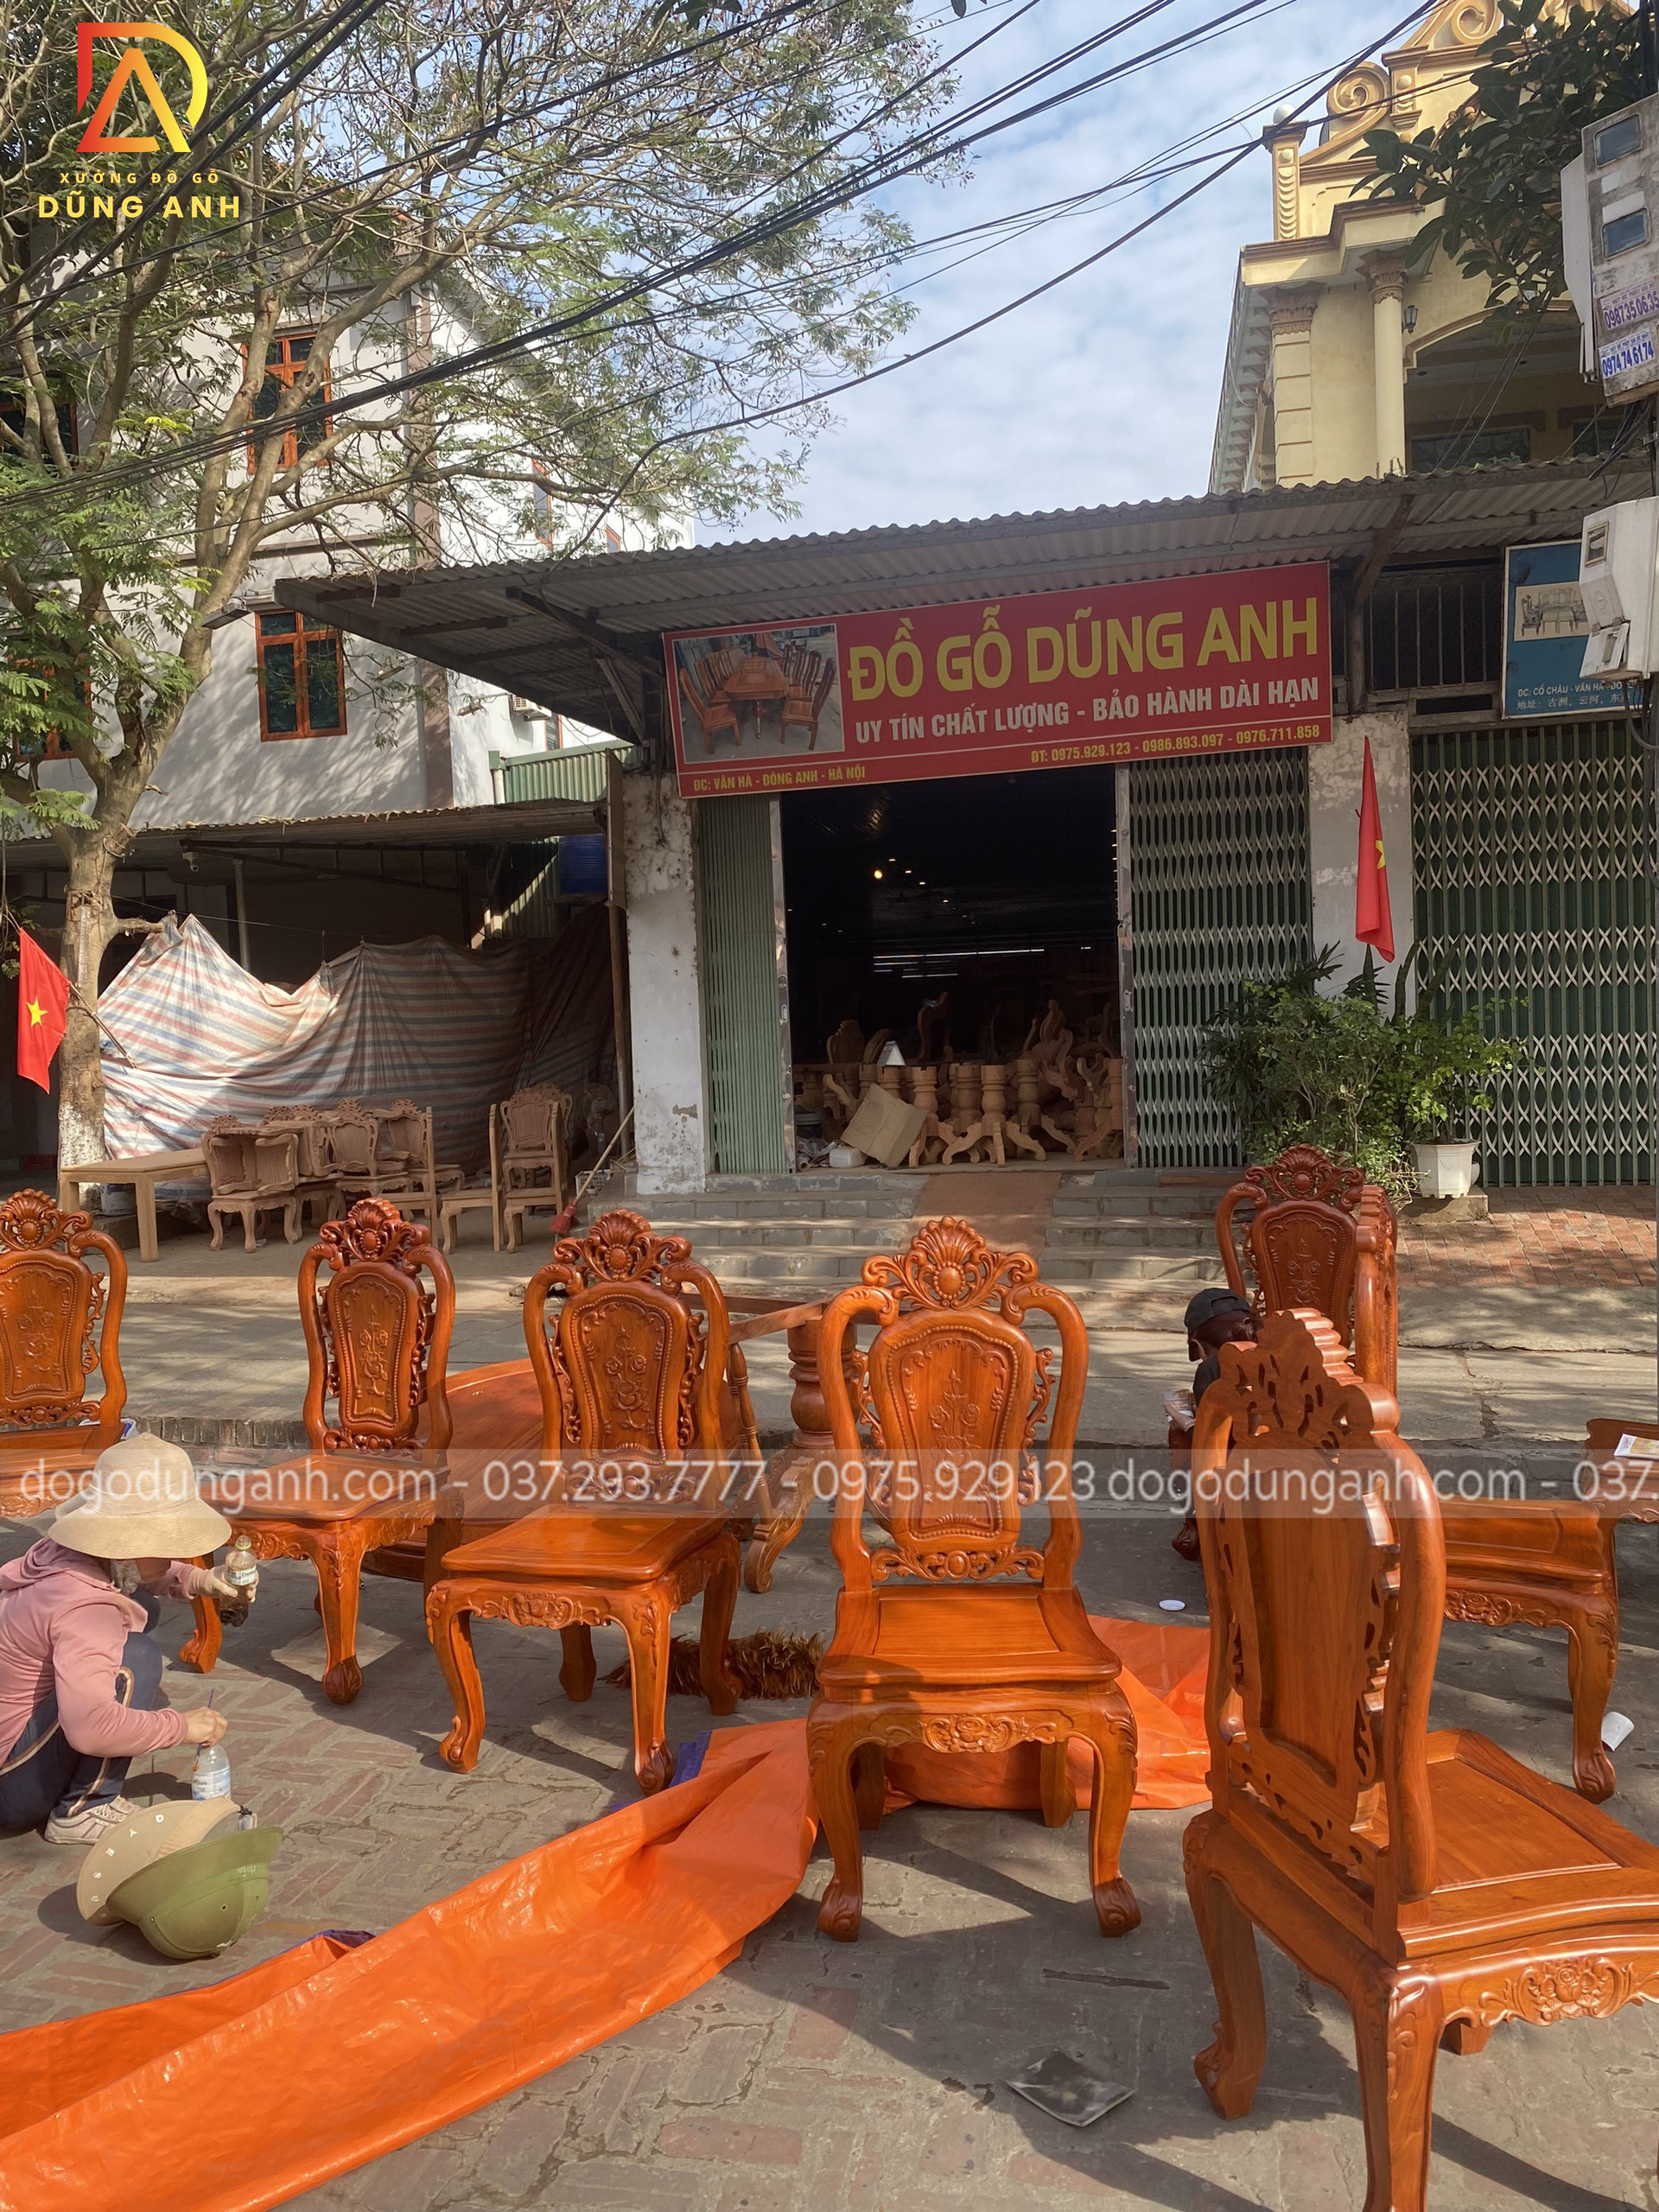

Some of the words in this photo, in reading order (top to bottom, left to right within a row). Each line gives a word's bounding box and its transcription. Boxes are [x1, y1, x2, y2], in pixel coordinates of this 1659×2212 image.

[847, 617, 924, 702] ĐỒ
[936, 604, 1013, 693] GỖ
[1026, 606, 1185, 684] DŨNG
[1196, 596, 1318, 667] ANH
[855, 720, 882, 744] UY
[888, 713, 925, 741] TÍN
[931, 702, 988, 738] CHẤT
[995, 702, 1069, 733] LƯỢNG
[1092, 689, 1140, 722] BẢO
[1147, 686, 1212, 716] HÀNH
[1220, 679, 1260, 709] DÀI
[1268, 677, 1319, 709] HẠN
[1051, 741, 1131, 761] 0975.929.123
[1142, 733, 1224, 753] 0986.893.097
[1236, 724, 1320, 745] 0976.711.858
[714, 775, 735, 790] VÂN
[738, 773, 753, 788] HÀ
[762, 771, 792, 786] ĐÔNG
[796, 770, 818, 784] ANH
[828, 767, 843, 781] HÀ
[846, 764, 866, 782] NỘI
